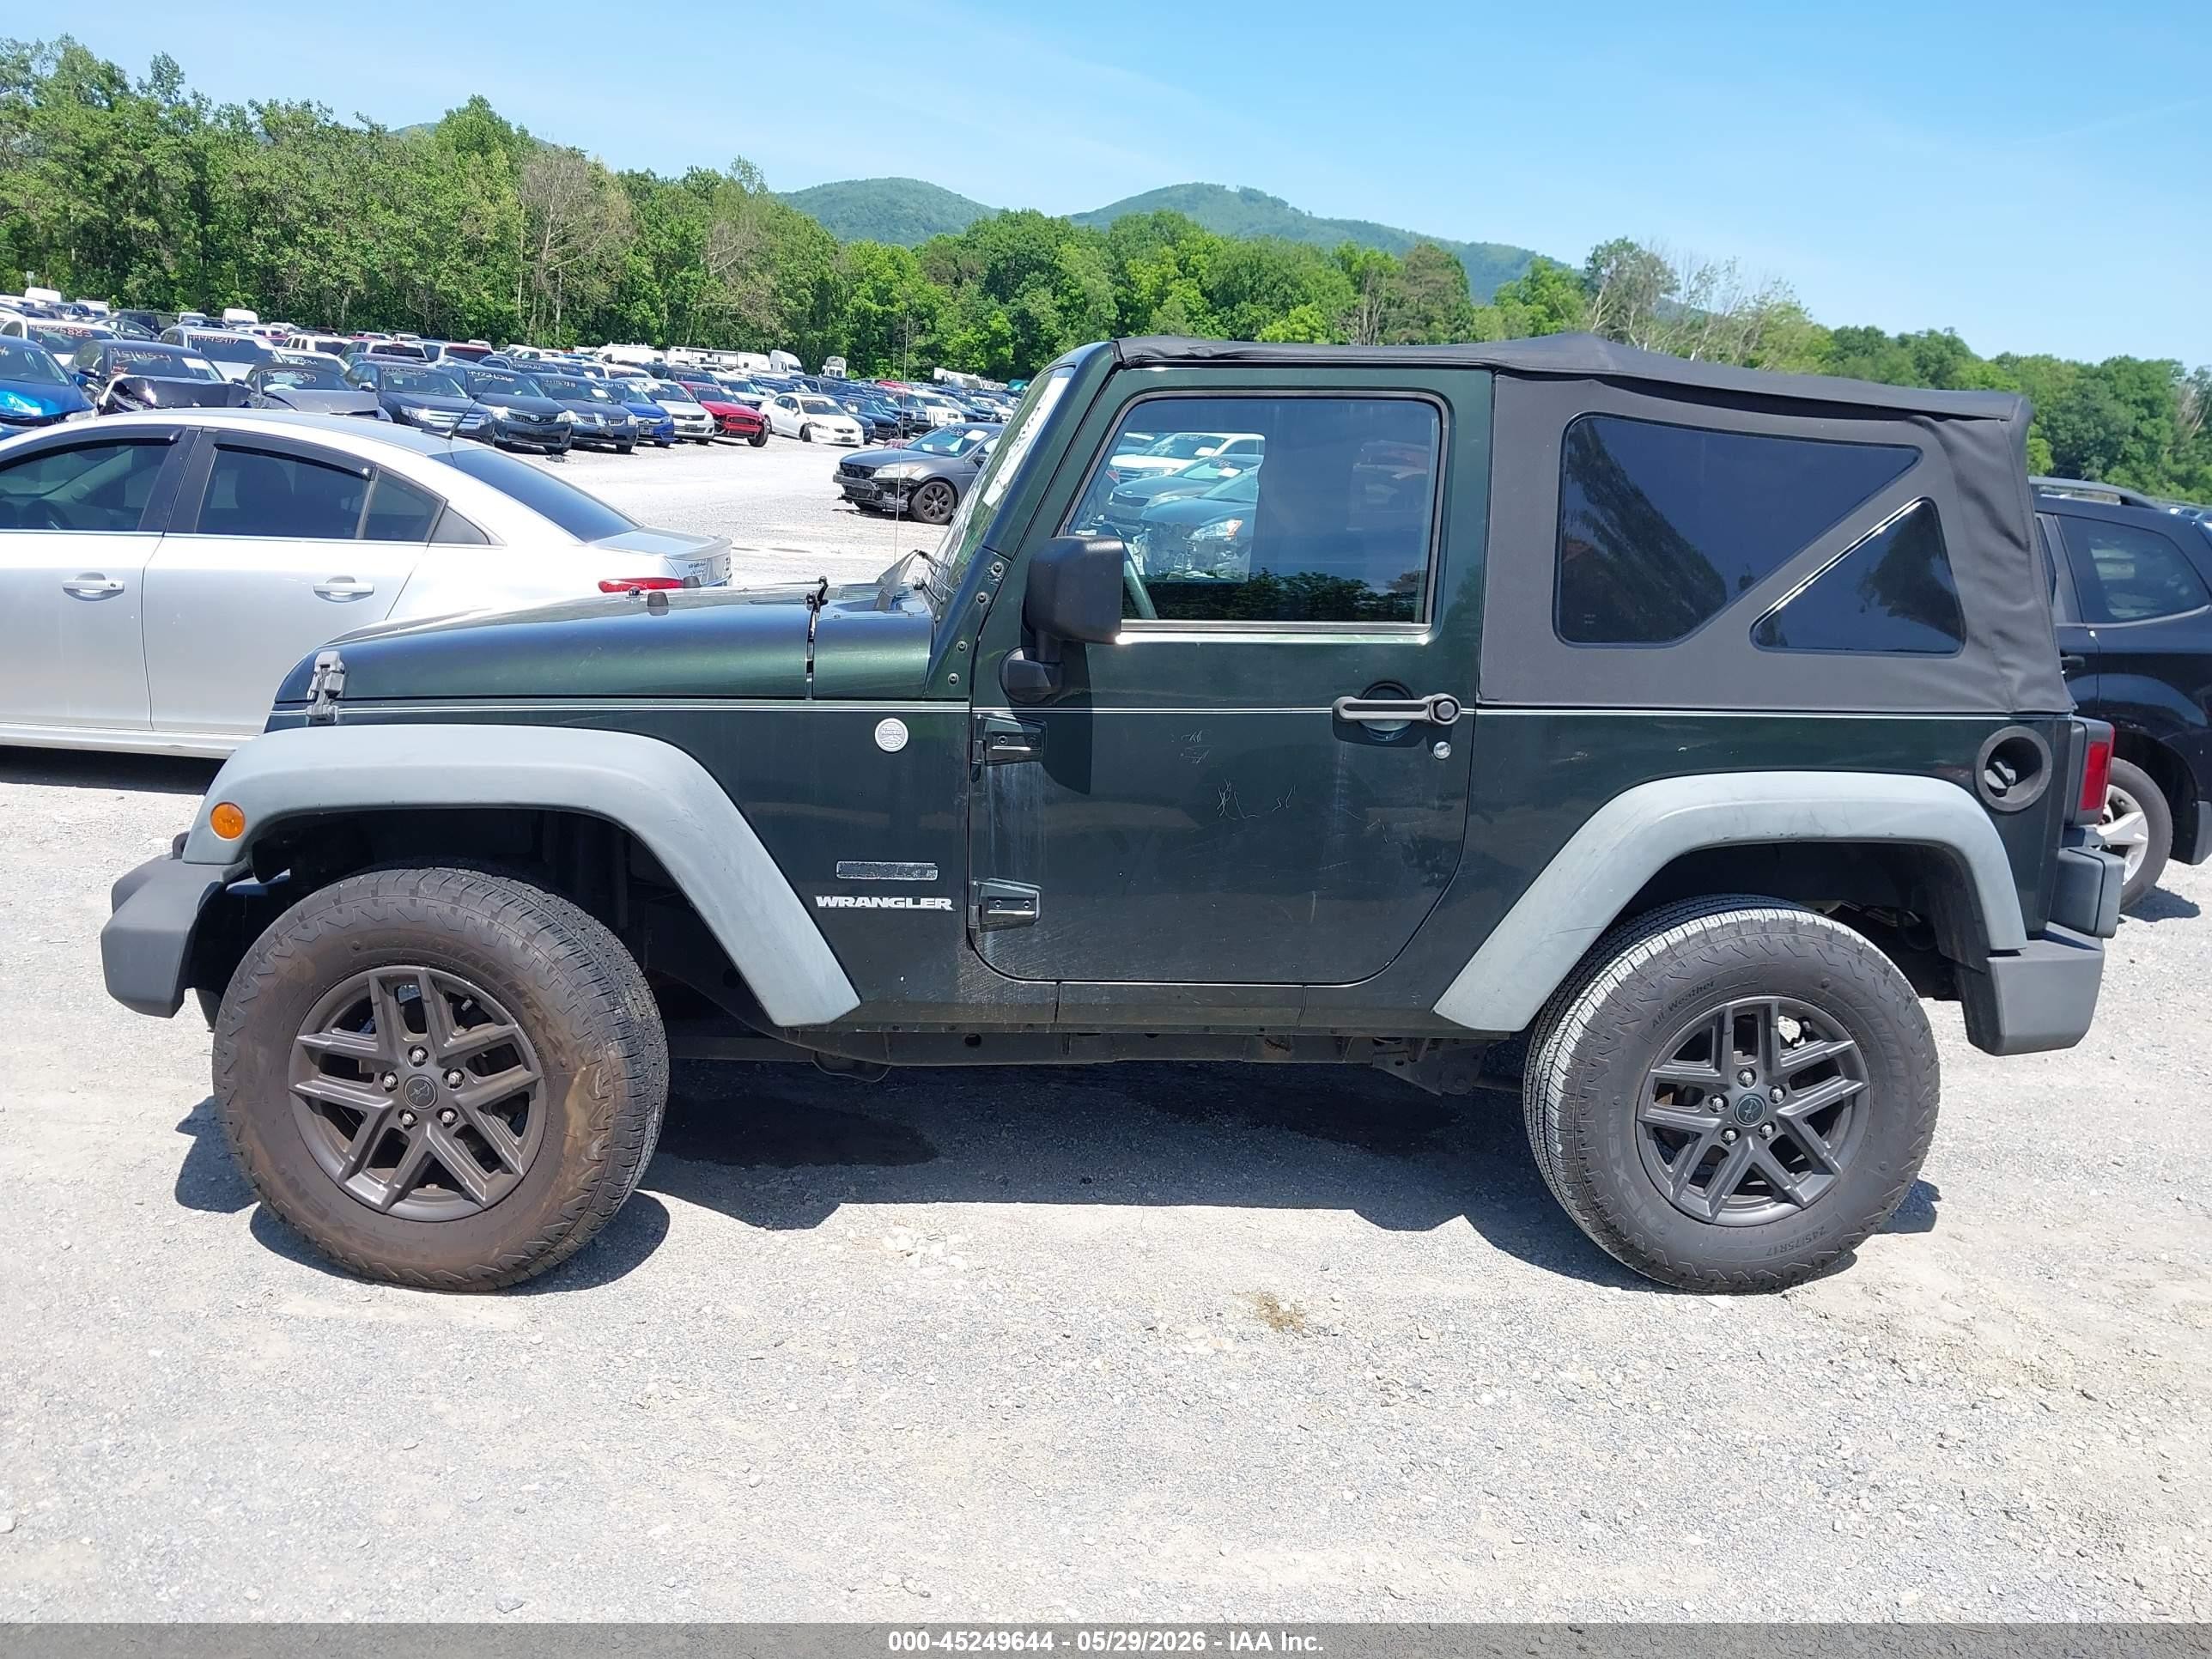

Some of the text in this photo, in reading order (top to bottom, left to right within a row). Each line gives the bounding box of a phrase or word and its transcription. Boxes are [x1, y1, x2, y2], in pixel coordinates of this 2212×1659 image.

[816, 896, 955, 911] WRANGLER
[1651, 981, 1716, 1029] All Weather
